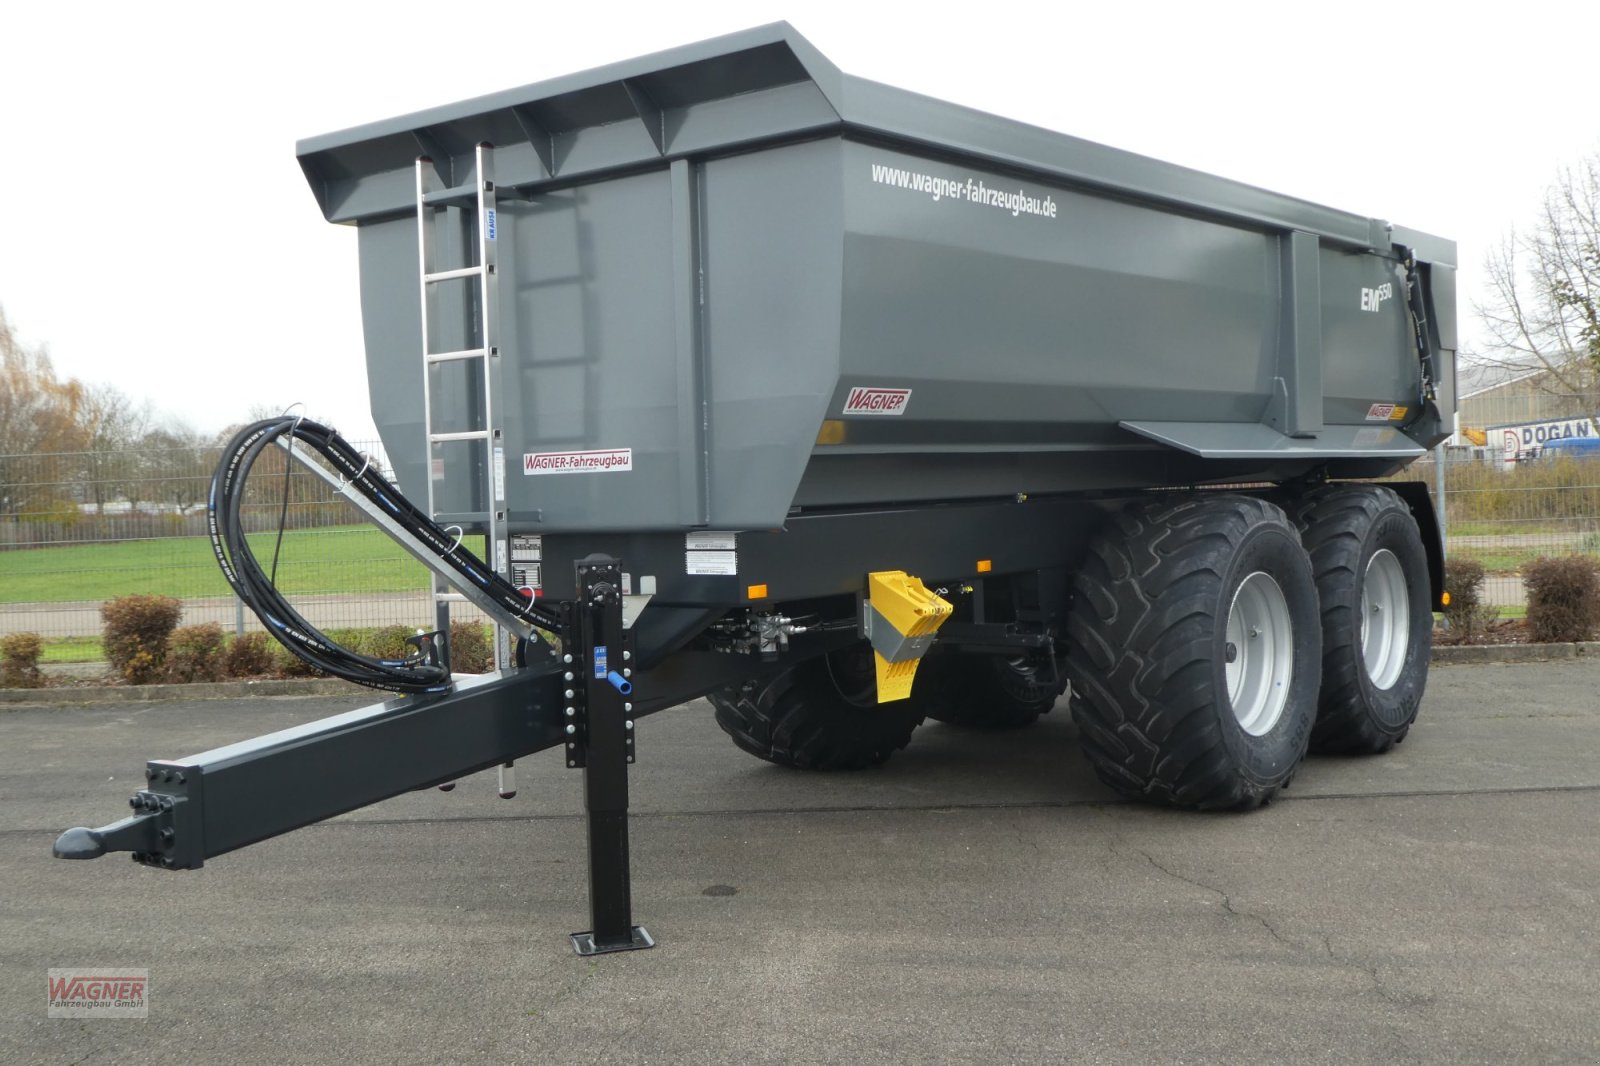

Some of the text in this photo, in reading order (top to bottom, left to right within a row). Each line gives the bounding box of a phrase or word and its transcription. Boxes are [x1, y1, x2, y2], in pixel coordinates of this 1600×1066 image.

[872, 164, 1057, 218] www.wagner-fahrzeugbau.de
[848, 389, 908, 409] WAGNER
[1522, 421, 1589, 445] DOGAN
[525, 451, 629, 470] WAGNER-Fahrzeugbau
